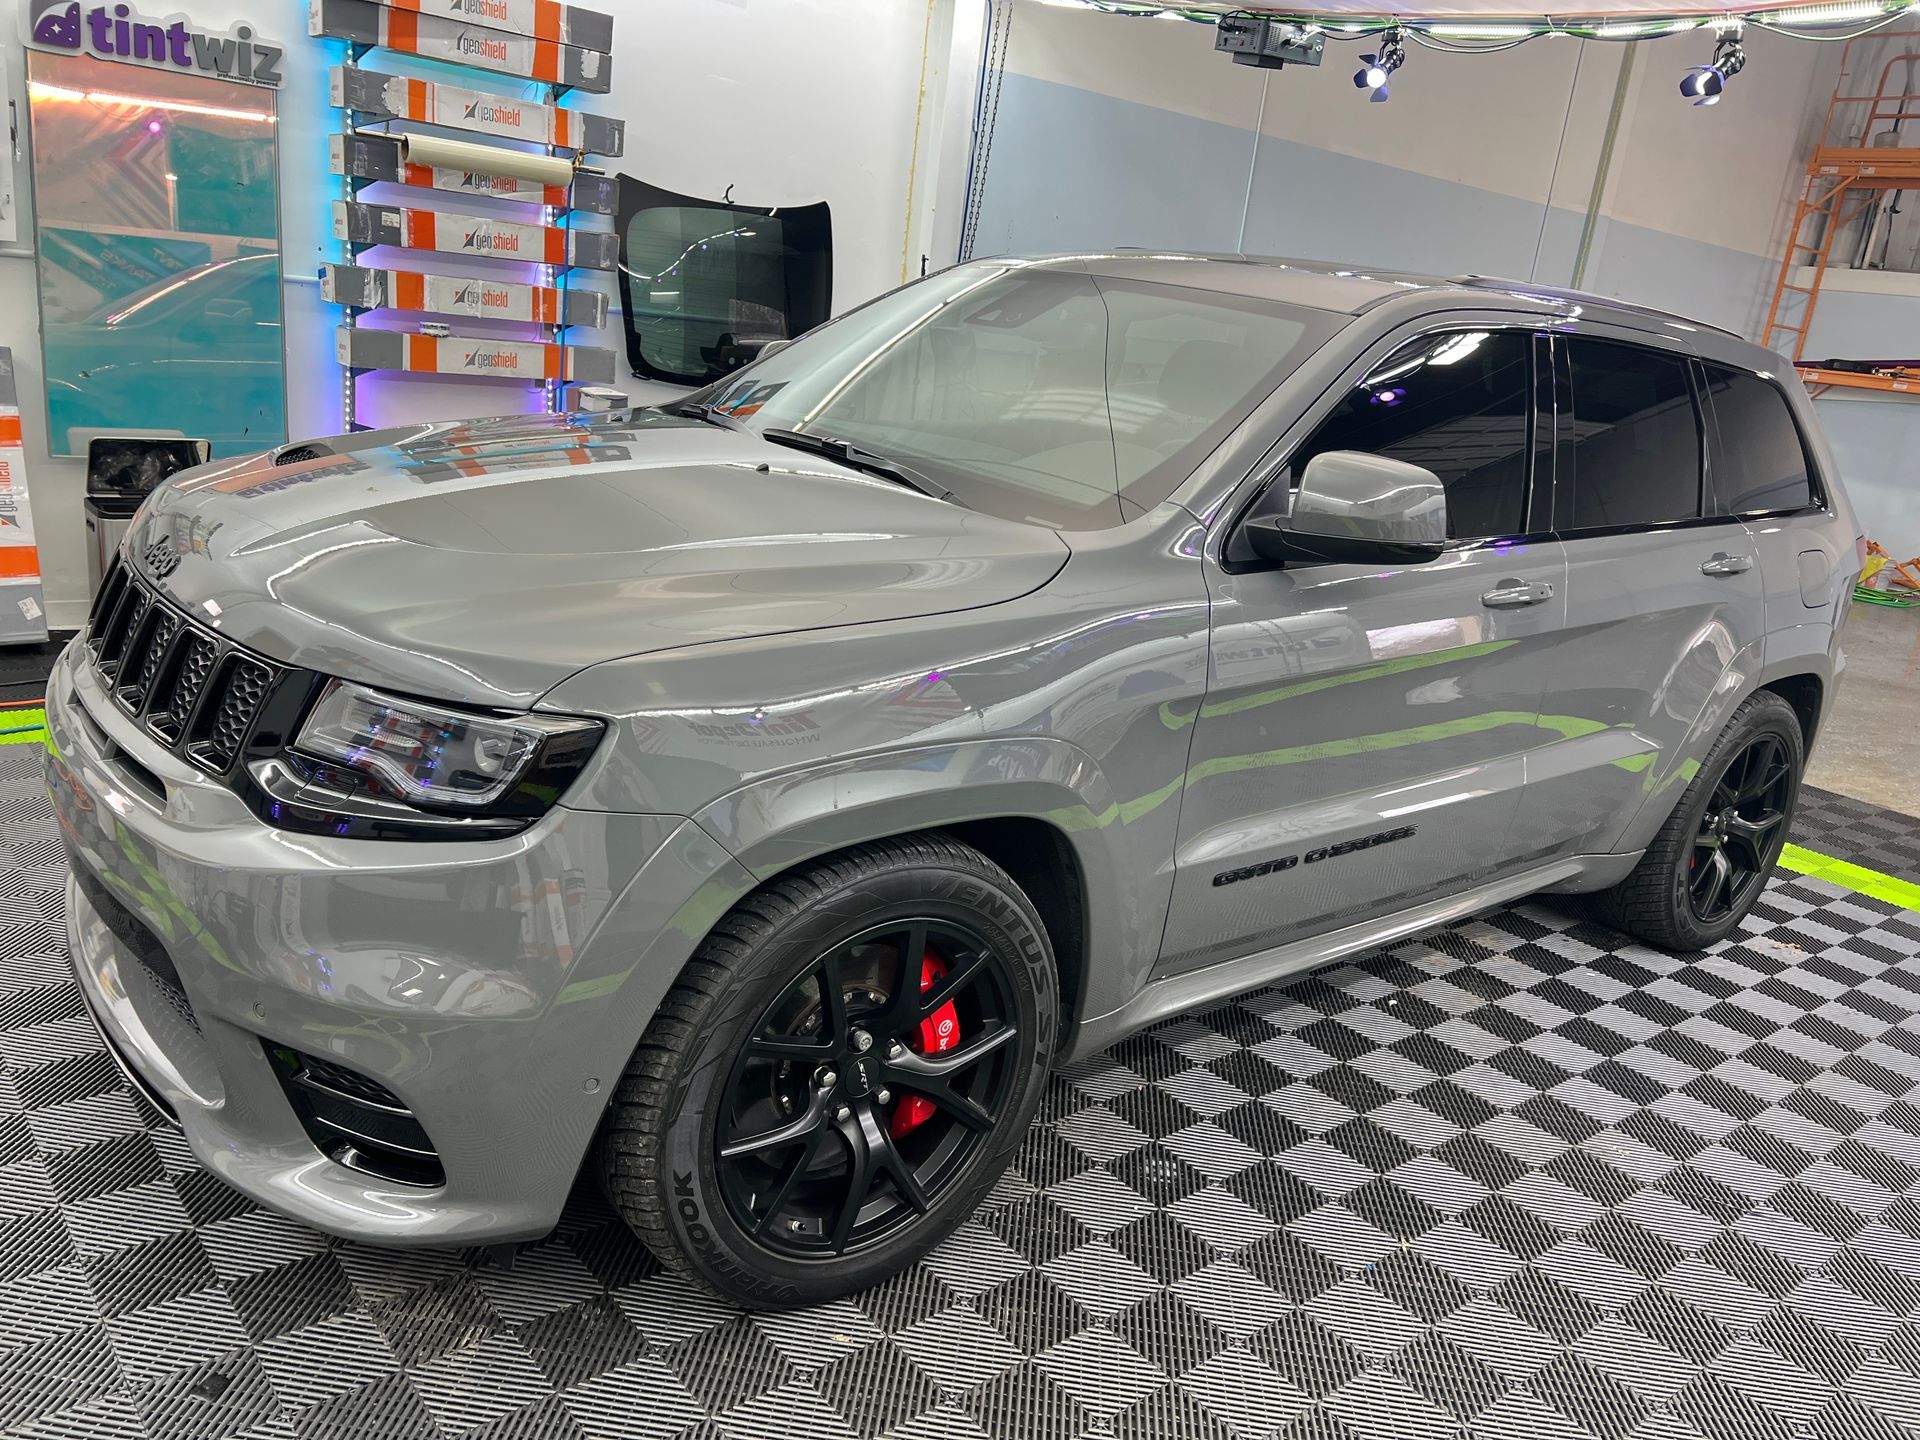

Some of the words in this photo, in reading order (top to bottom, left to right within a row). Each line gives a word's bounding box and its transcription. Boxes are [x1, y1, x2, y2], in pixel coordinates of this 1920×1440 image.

[464, 0, 507, 21] geoshield
[87, 4, 282, 82] tintwiz
[463, 37, 507, 61] geoshield
[216, 72, 255, 86] professionally
[476, 231, 519, 252] geoshield
[477, 351, 518, 369] geoshield
[1212, 854, 1299, 888] GRAND
[1303, 823, 1419, 864] CHEROKEE
[928, 875, 1051, 995] VENTUS
[857, 1061, 869, 1091] SRT
